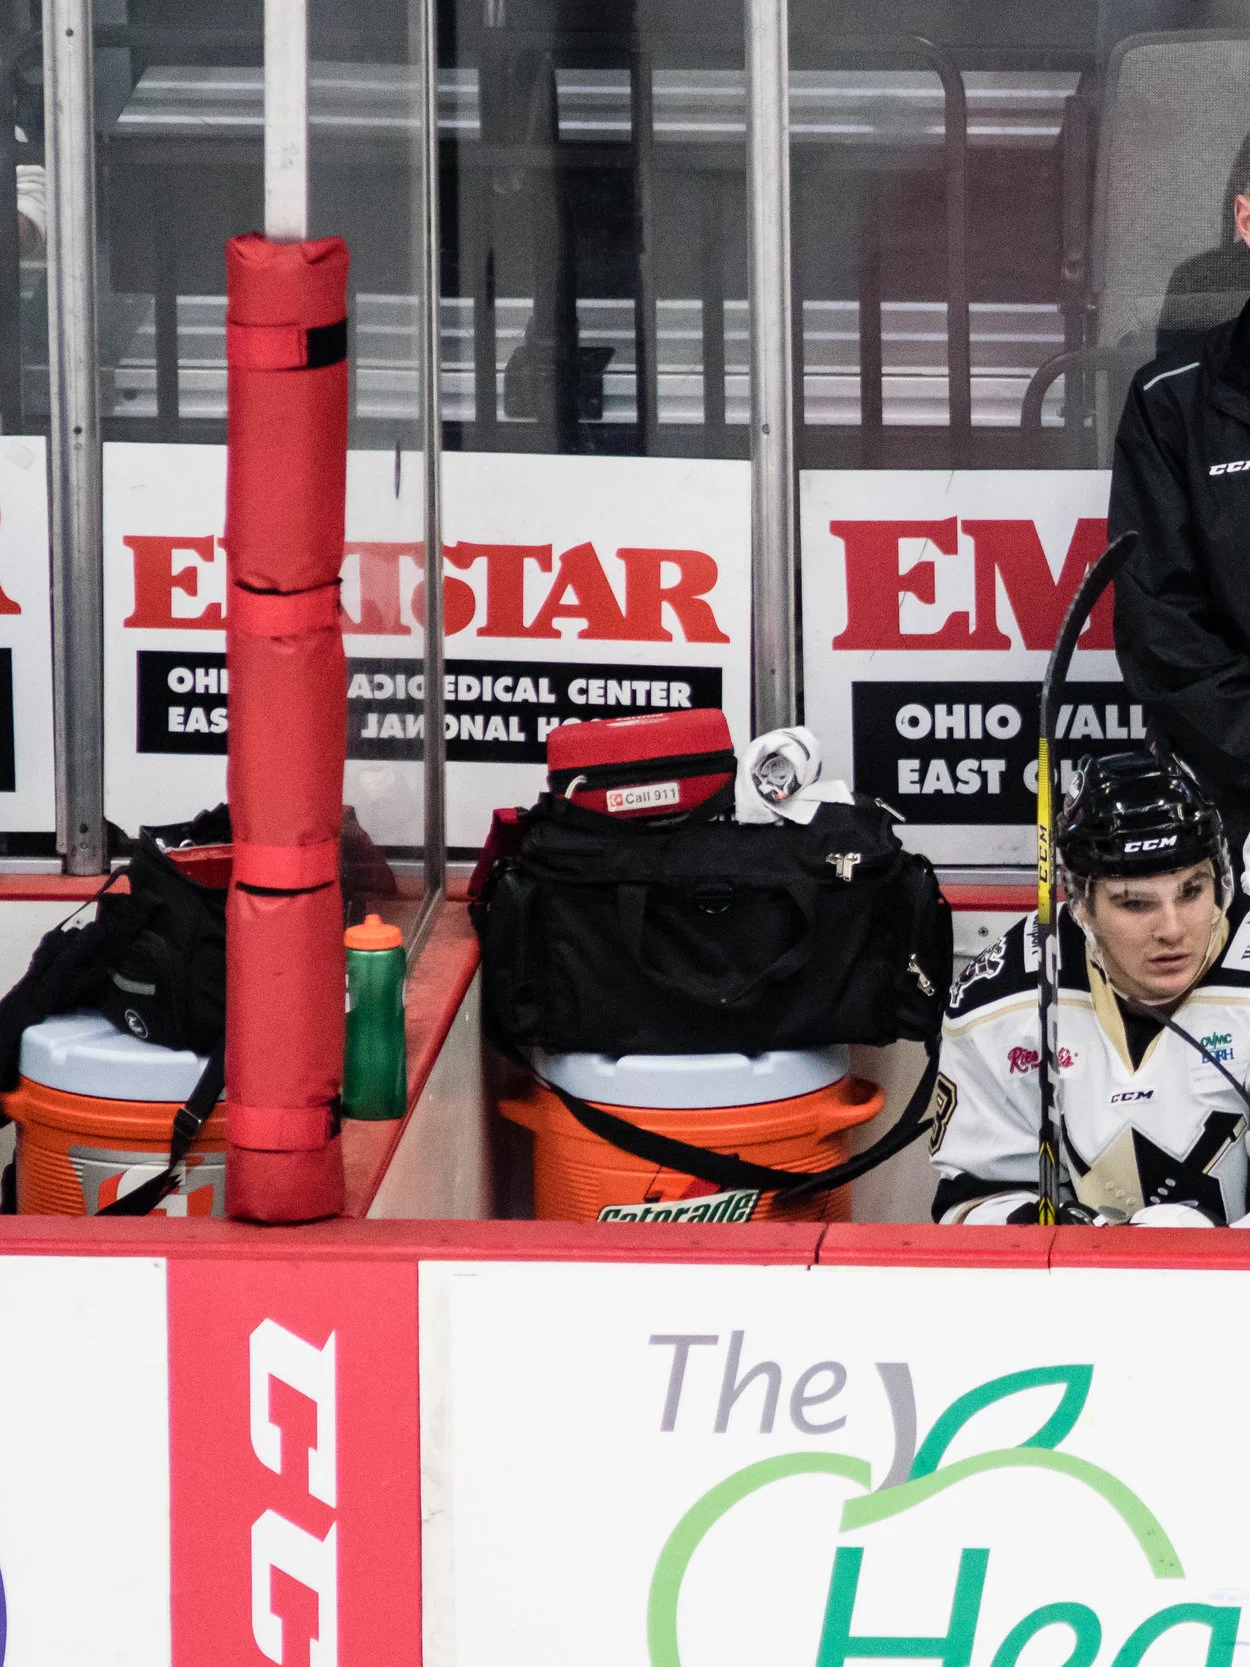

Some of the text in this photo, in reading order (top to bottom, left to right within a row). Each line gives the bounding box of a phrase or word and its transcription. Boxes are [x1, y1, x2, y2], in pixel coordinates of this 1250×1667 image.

[444, 674, 692, 708] EDICAL CENTER
[167, 706, 229, 734] EAS
[895, 703, 1022, 740] OHIO
[897, 759, 1006, 794] EAST
[625, 787, 677, 805] Call 911
[1039, 824, 1048, 884] CCM
[1124, 835, 1178, 853] CCM
[1110, 1089, 1154, 1104] CCM
[648, 1330, 847, 1435] The
